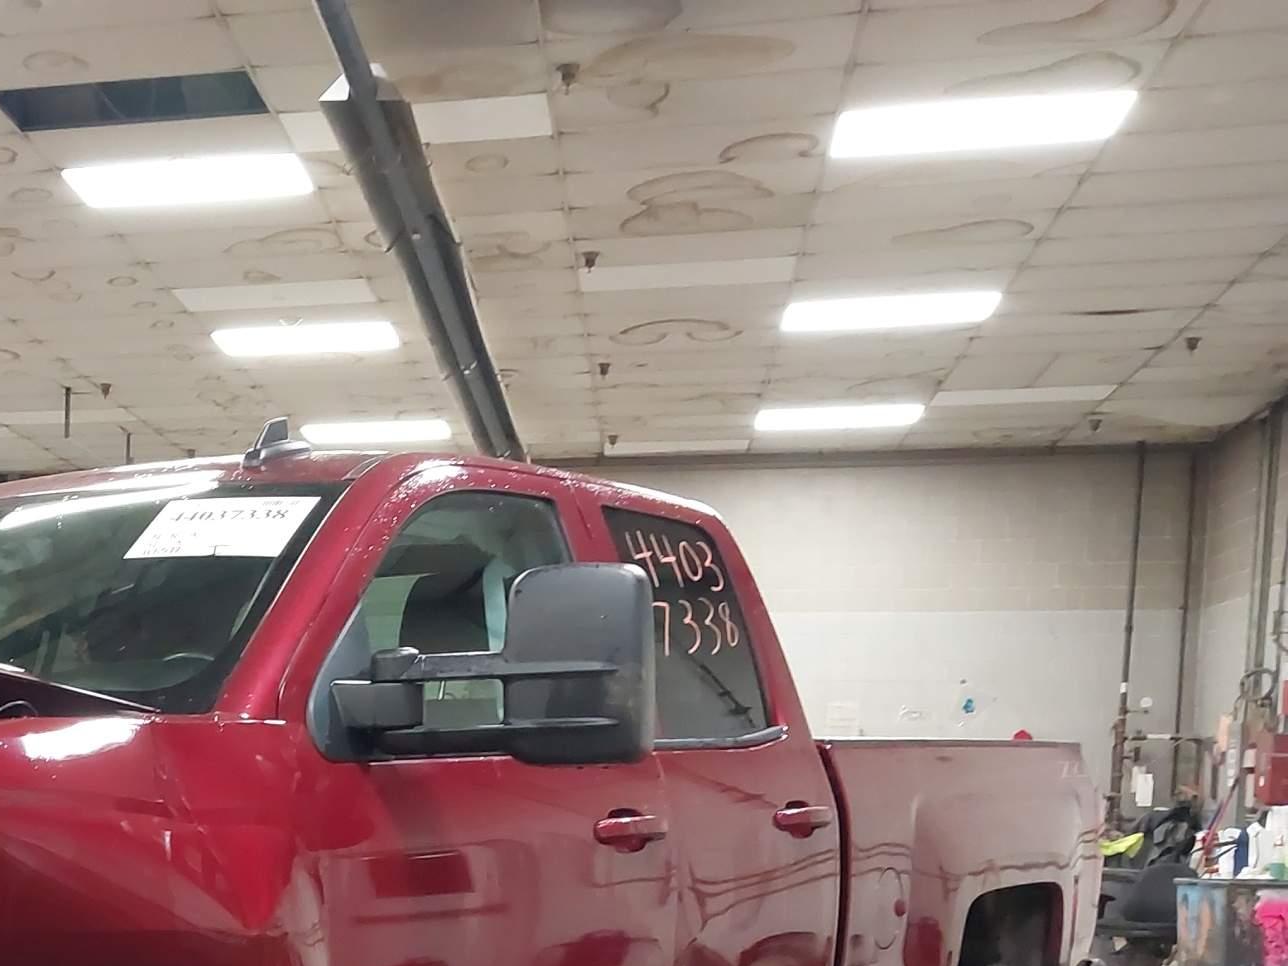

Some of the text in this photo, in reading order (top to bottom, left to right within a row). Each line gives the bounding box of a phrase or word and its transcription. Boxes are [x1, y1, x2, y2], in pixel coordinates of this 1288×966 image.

[170, 509, 289, 522] 44037338
[625, 530, 725, 592] 4403
[651, 597, 740, 657] 7338
